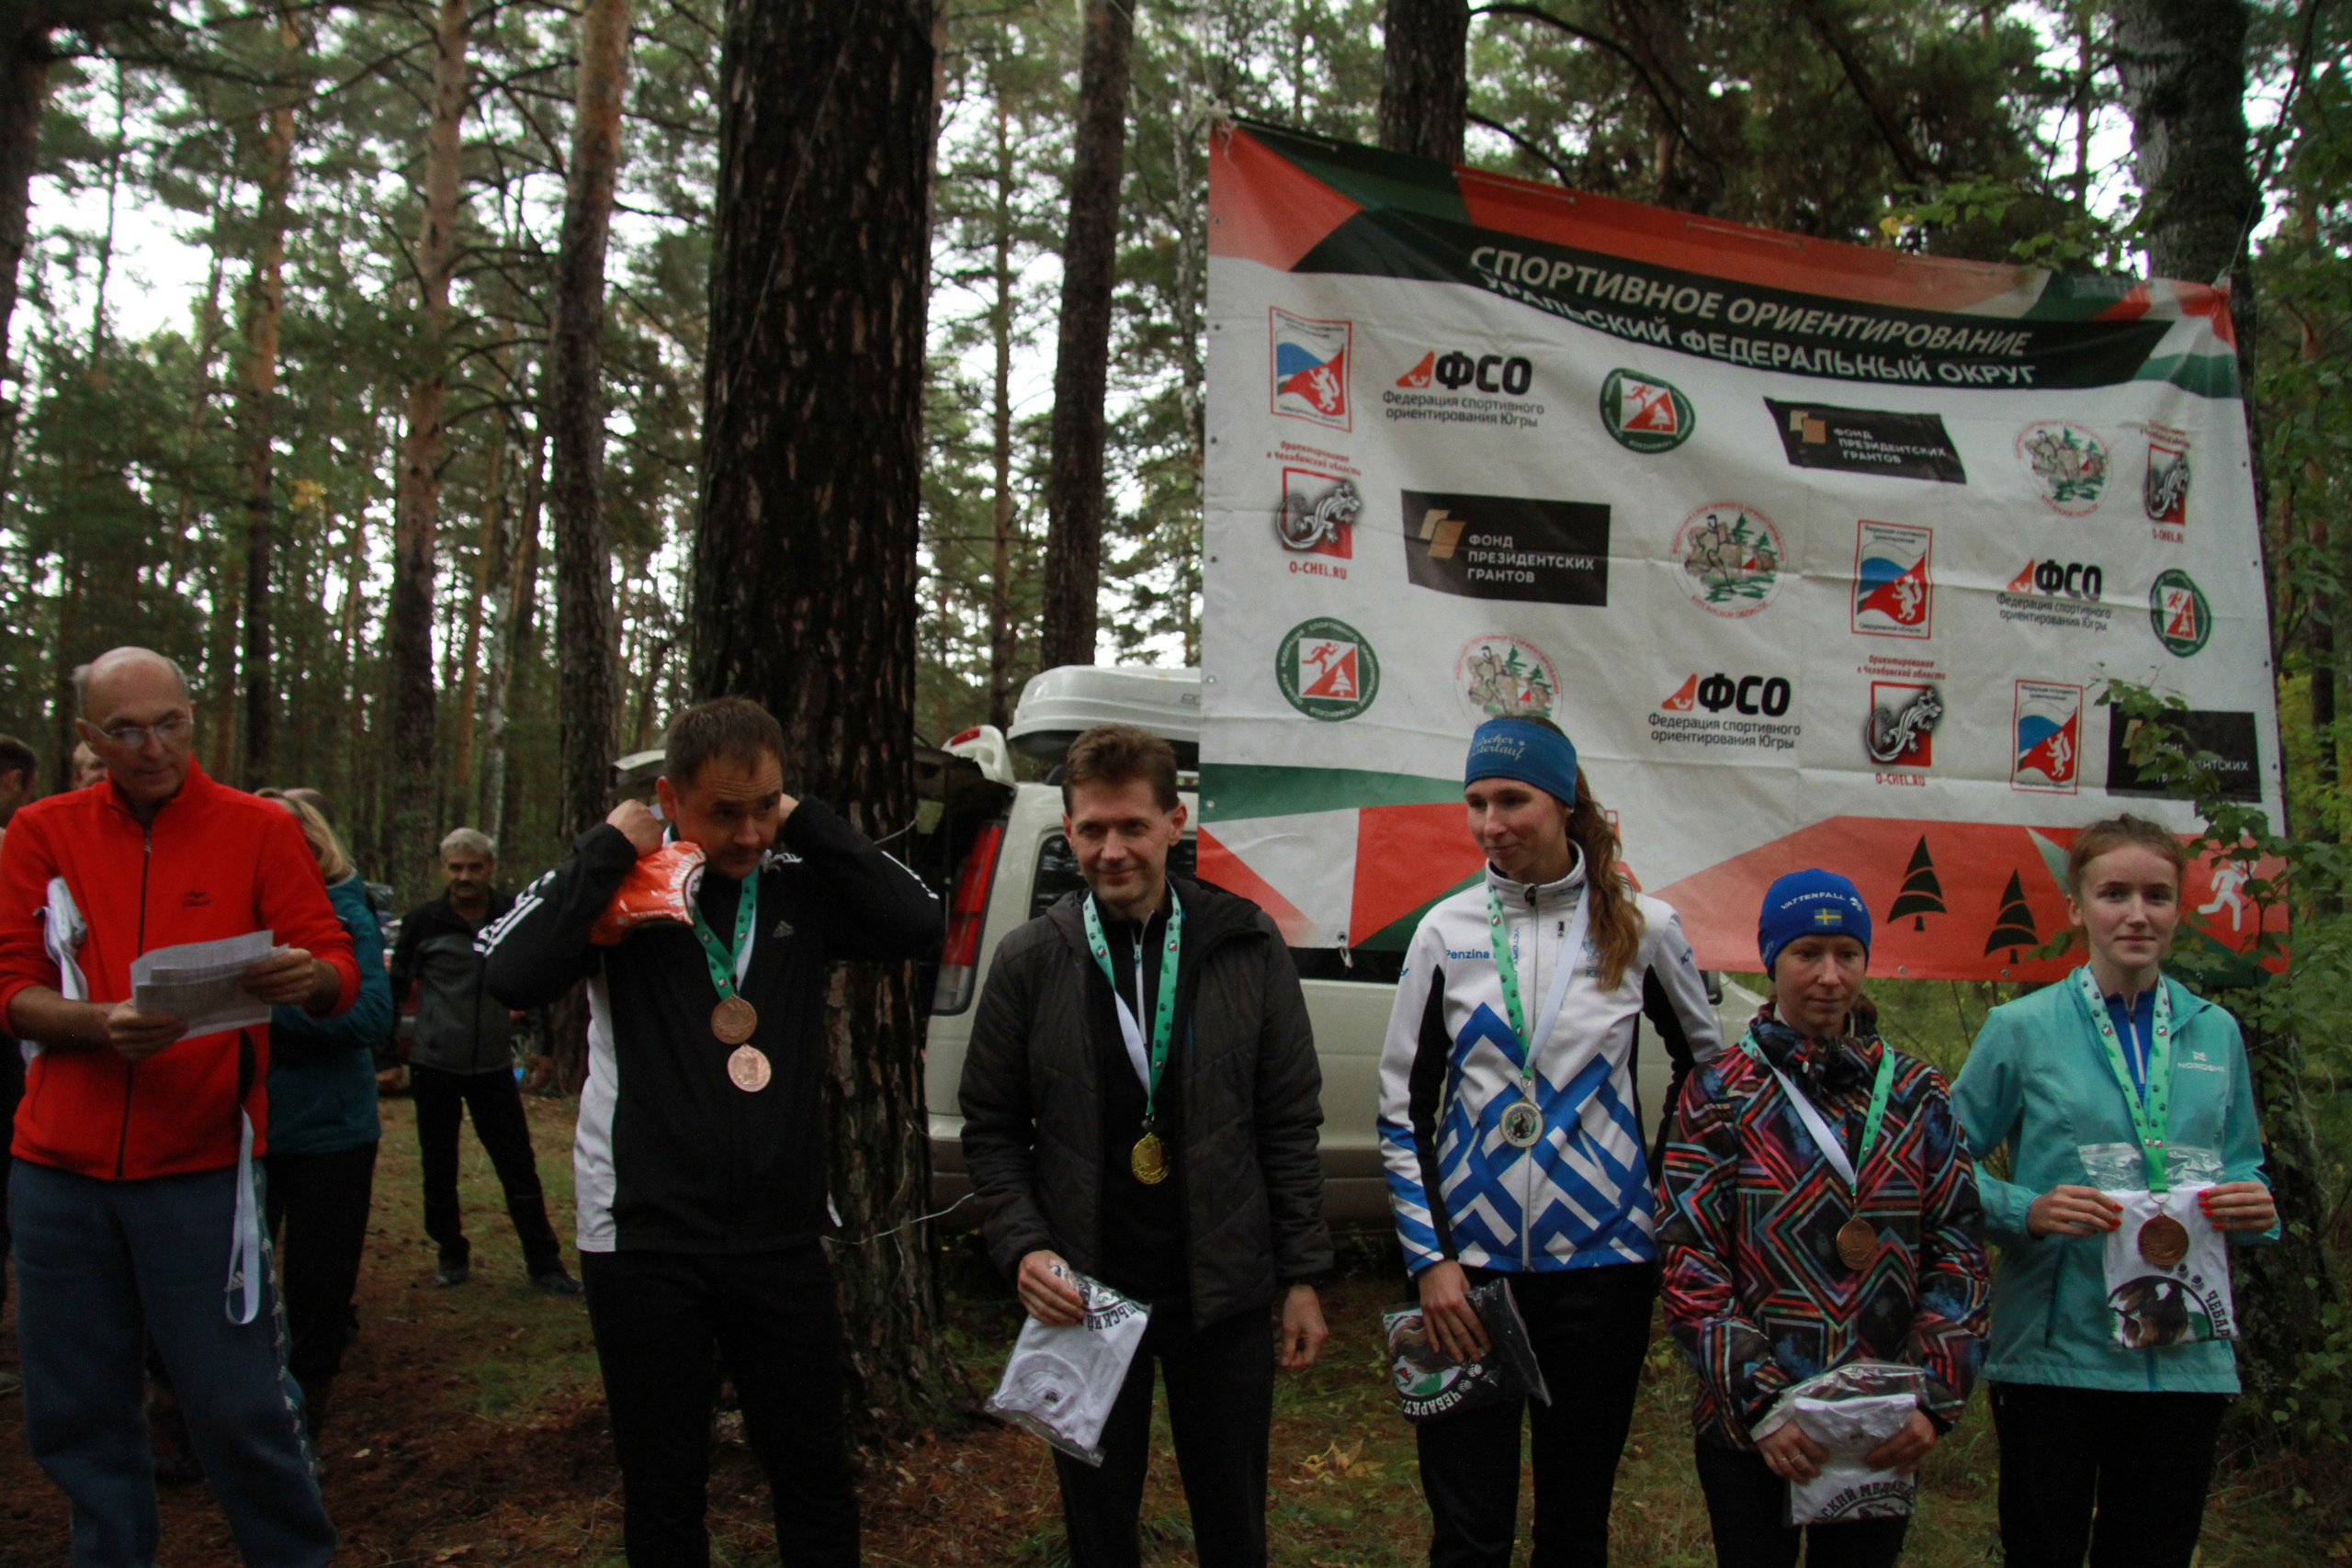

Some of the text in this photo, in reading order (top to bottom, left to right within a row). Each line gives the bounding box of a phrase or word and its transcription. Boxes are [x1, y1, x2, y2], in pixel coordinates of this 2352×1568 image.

[1471, 246, 2032, 356] СПОРТИВНОЕ ОРИЕНТИРОВАНИЕ
[1680, 330, 1931, 381] ФЕДЕРАЛЬНЫЙ
[1938, 363, 2036, 384] ОКРУГ
[1435, 350, 1532, 396] ФСО
[1383, 390, 1545, 414] Федерация спортивного
[1385, 407, 1538, 428] ориентирования Югры
[1468, 534, 1514, 549] ФОНД
[1468, 551, 1594, 570] ПРЕЗИДЕНТСКИХ
[1467, 568, 1535, 583] ГРАНТОВ
[2034, 558, 2102, 602] ФСО
[1996, 592, 2112, 619] Федерация спортивного
[1999, 609, 2080, 626] ориентирования
[1697, 672, 1792, 716] ФСО
[1648, 713, 1802, 736] Федерация спортивного
[1651, 729, 1794, 751] ориентирования Югры
[1780, 892, 1846, 909] VATTENFALL
[1445, 949, 1489, 961] Penzina
[1402, 1390, 1463, 1416] ЧЕБАРКУ
[1821, 1486, 1857, 1517] СКИЙ
